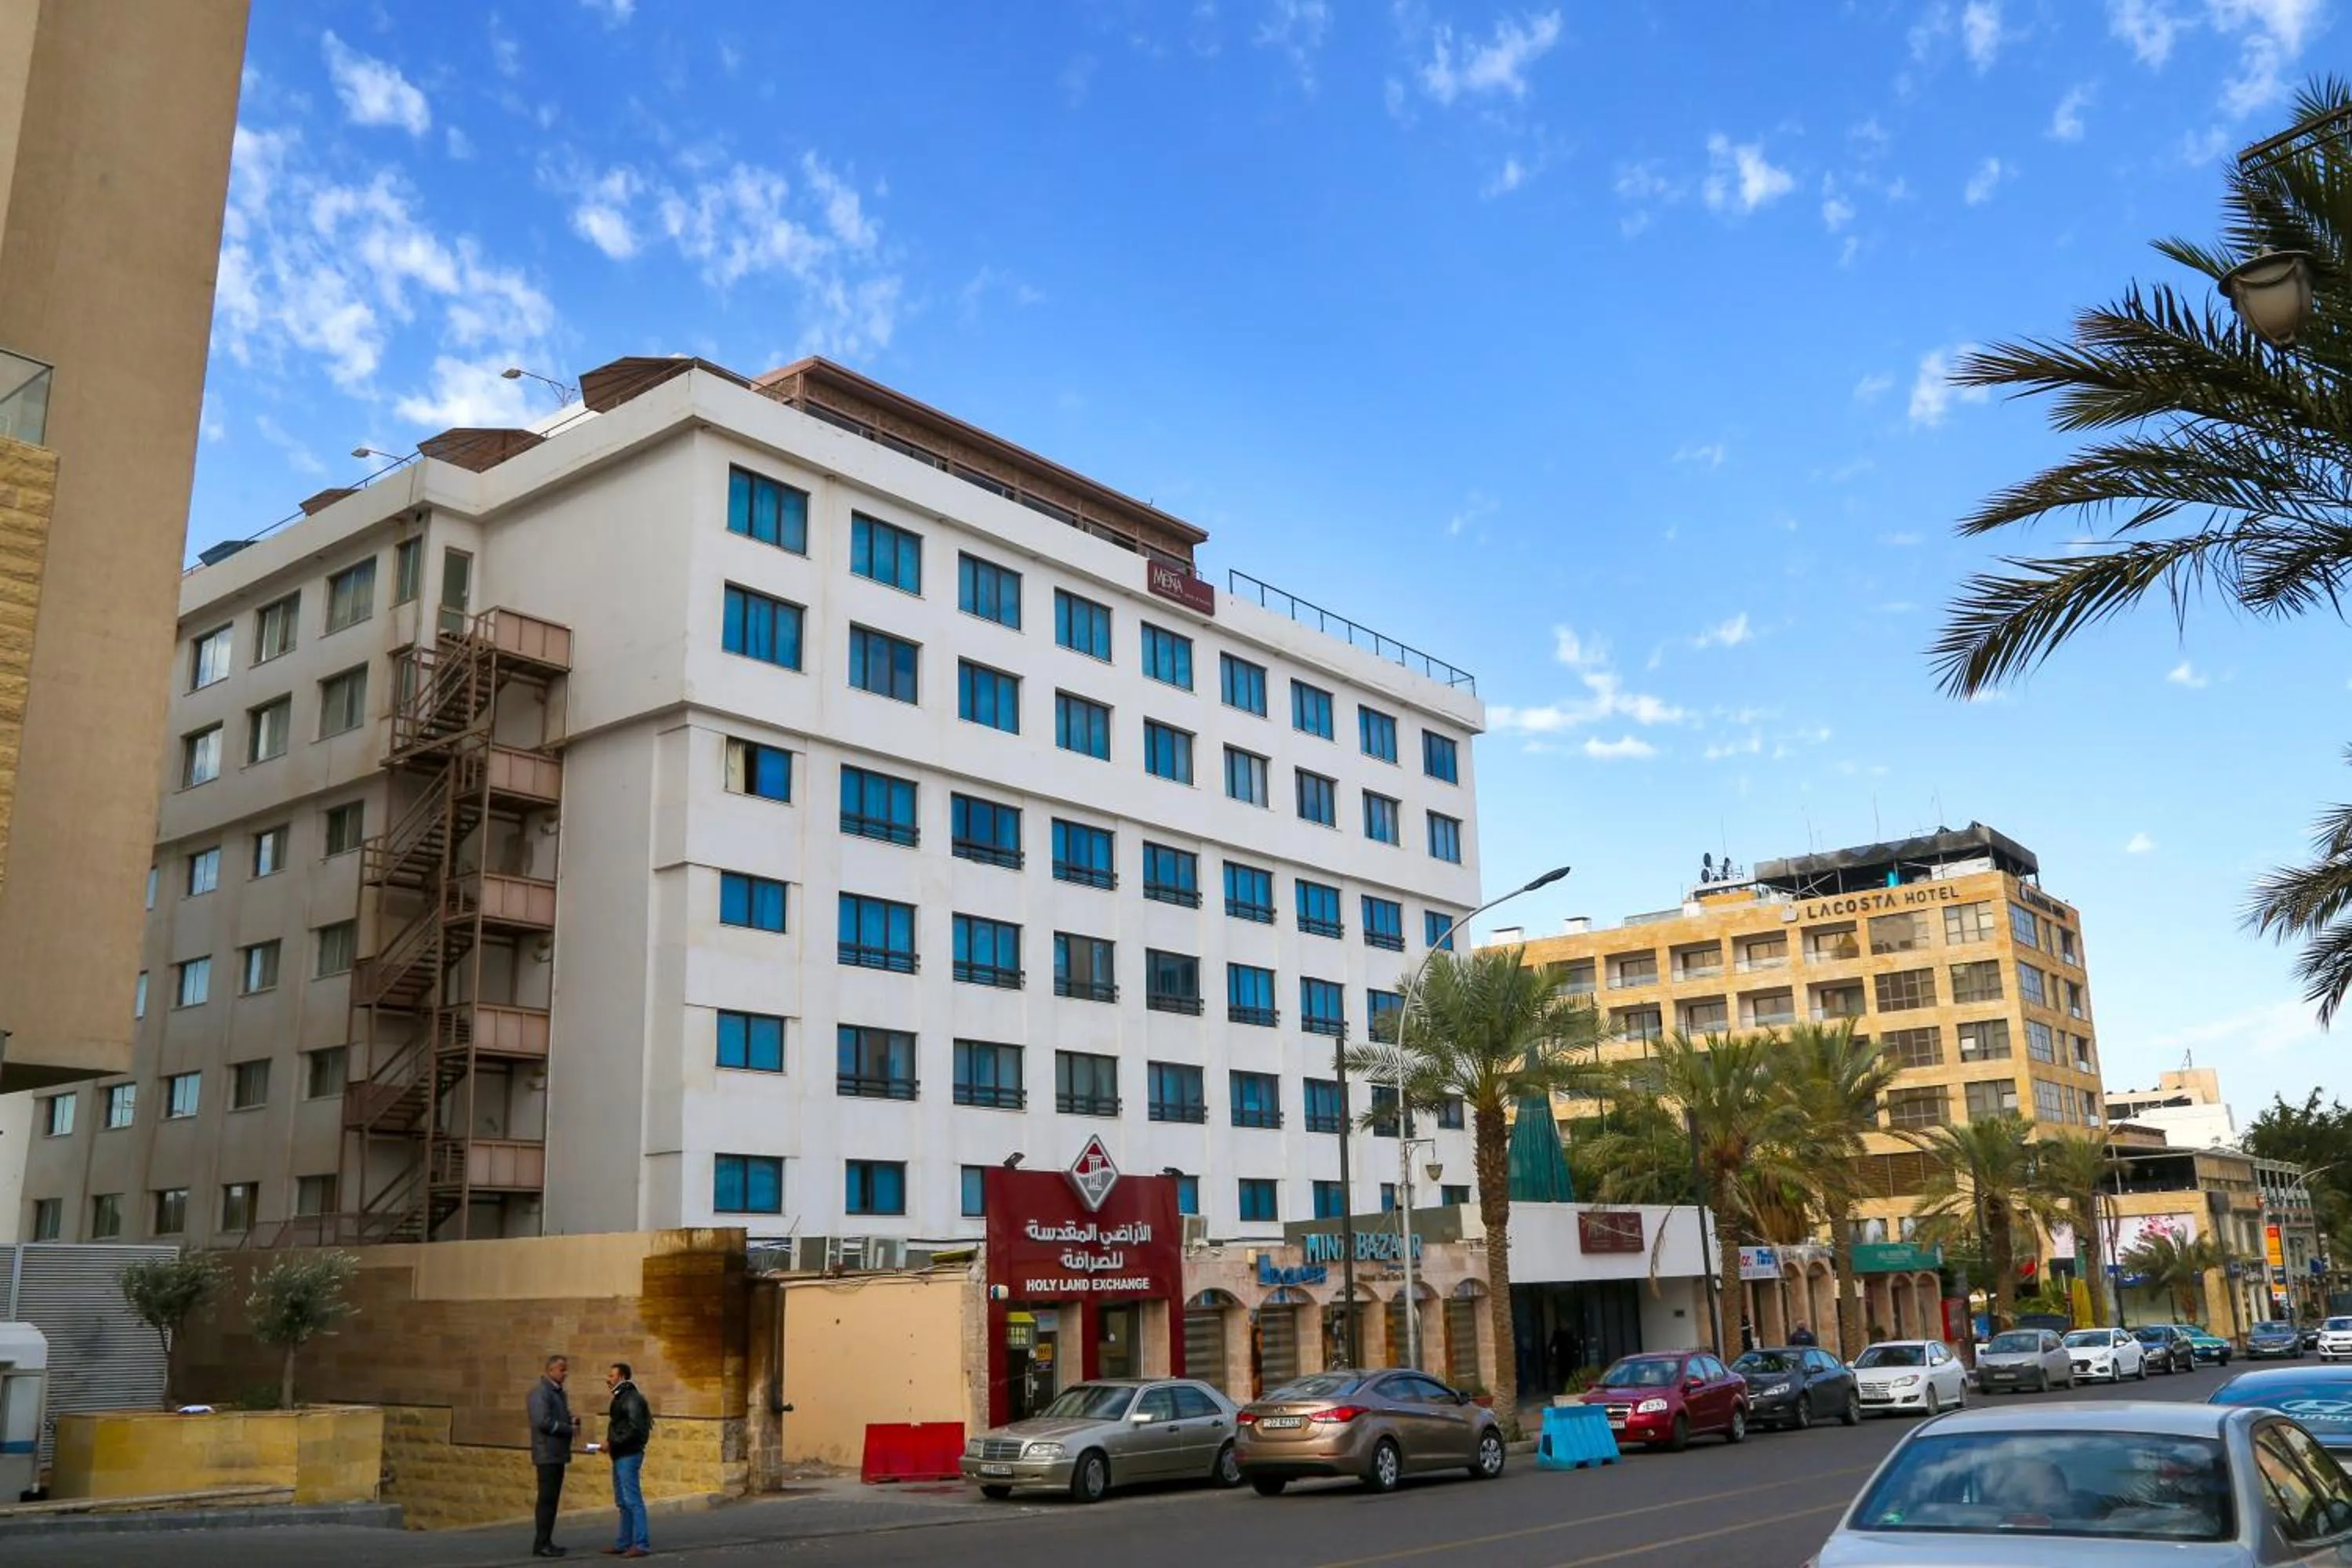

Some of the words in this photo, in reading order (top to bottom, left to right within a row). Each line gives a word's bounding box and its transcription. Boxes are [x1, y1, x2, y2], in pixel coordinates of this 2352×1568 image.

[1153, 567, 1184, 593] MENA
[1807, 894, 1896, 919] LACOSTA
[1905, 886, 1959, 904] HOTEL
[1025, 1219, 1097, 1243] المقدسة
[1060, 1247, 1123, 1273] للصرافة
[1026, 1279, 1058, 1292] HOLY
[1060, 1279, 1090, 1291] LAND
[1092, 1277, 1151, 1290] EXCHANGE
